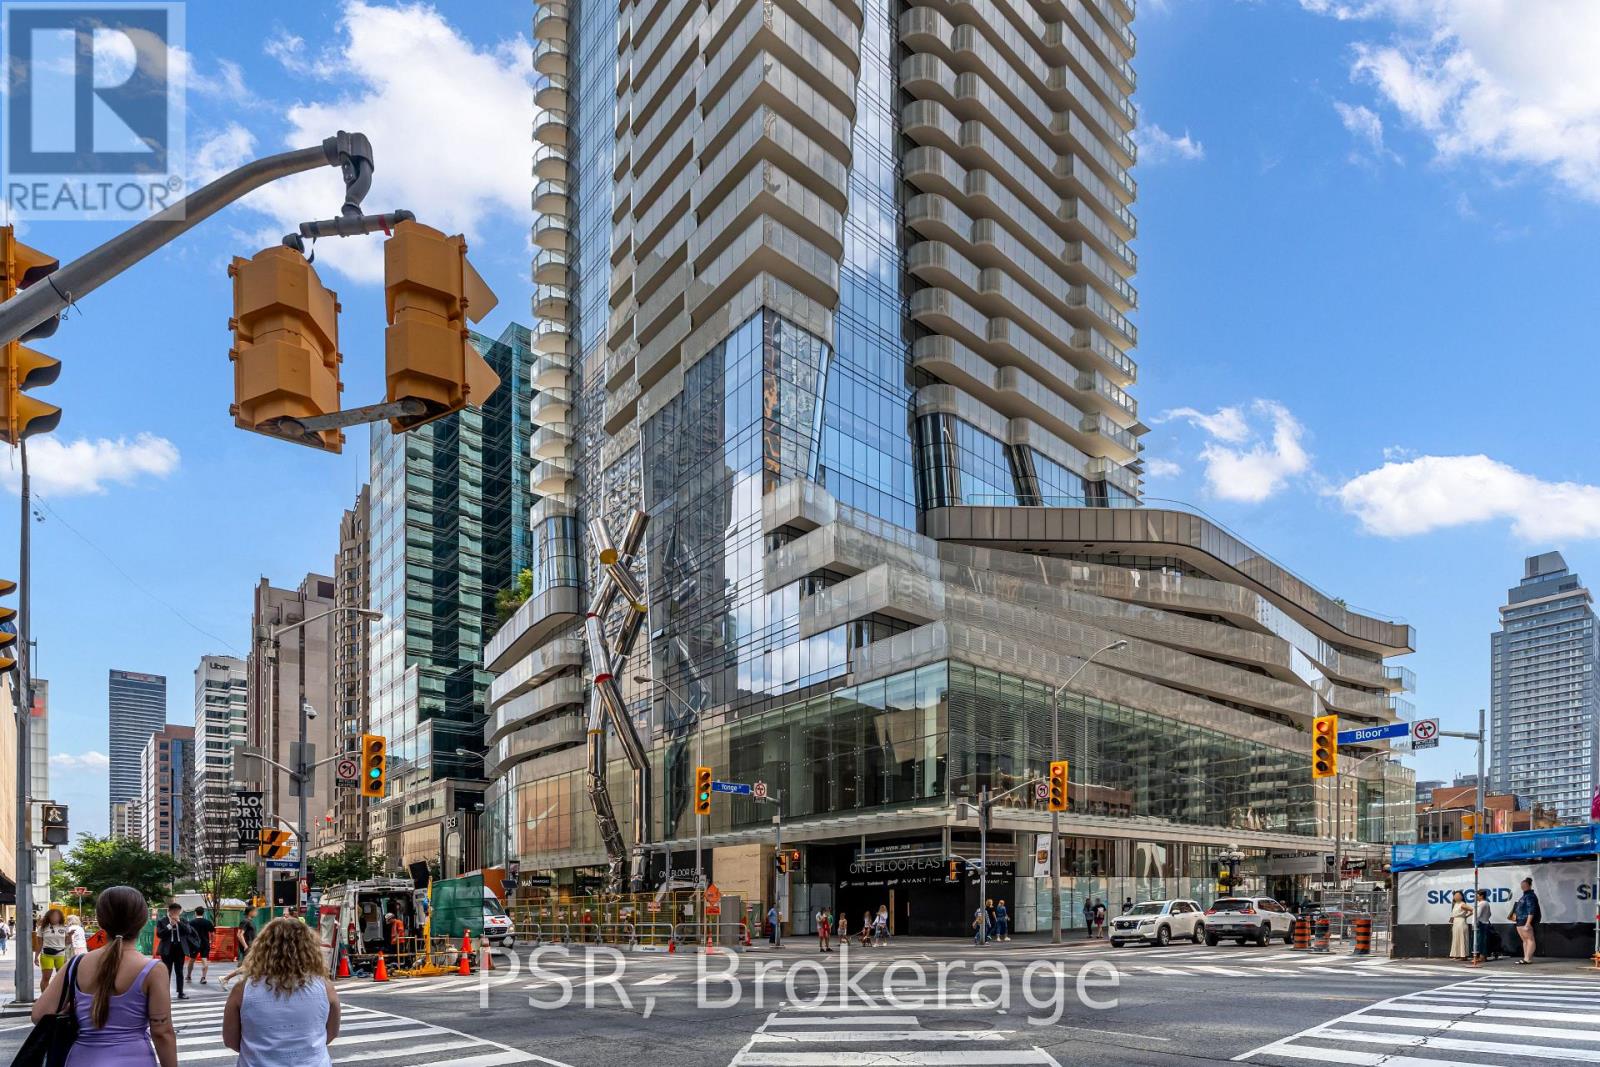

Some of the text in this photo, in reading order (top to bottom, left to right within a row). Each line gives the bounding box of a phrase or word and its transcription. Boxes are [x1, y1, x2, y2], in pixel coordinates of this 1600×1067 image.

[209, 662, 230, 671] Uber
[1355, 729, 1382, 740] Bloor
[721, 784, 738, 792] Yonge
[849, 857, 945, 874] ONE BLOOR EAST
[1427, 887, 1513, 905] SKGRiD
